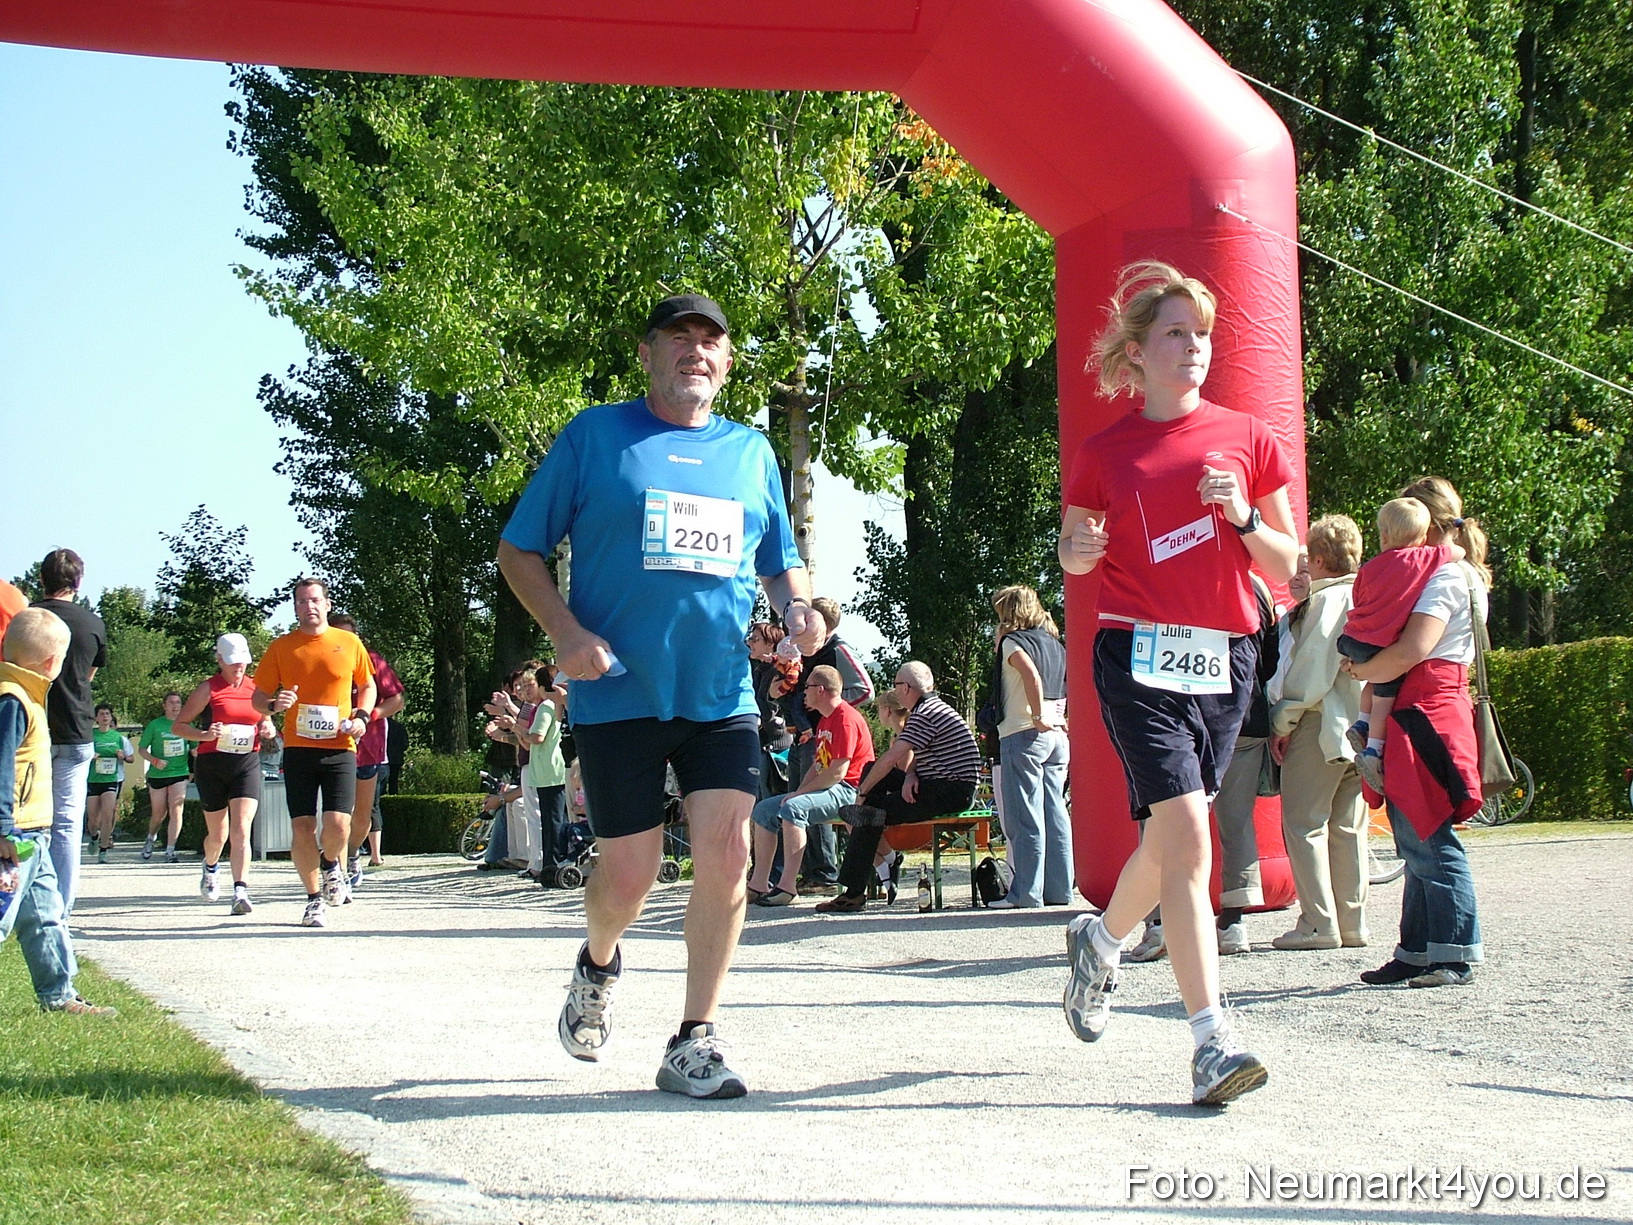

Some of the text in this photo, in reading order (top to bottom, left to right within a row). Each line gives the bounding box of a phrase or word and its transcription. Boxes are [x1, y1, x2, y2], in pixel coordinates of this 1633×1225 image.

[673, 501, 698, 516] Willi
[649, 521, 656, 532] D
[674, 528, 732, 554] 2201
[1169, 529, 1196, 550] DEHN
[1161, 624, 1192, 639] Julia
[1136, 642, 1144, 653] D
[1160, 650, 1221, 677] 2486
[308, 720, 334, 731] 1028
[233, 737, 249, 746] 123
